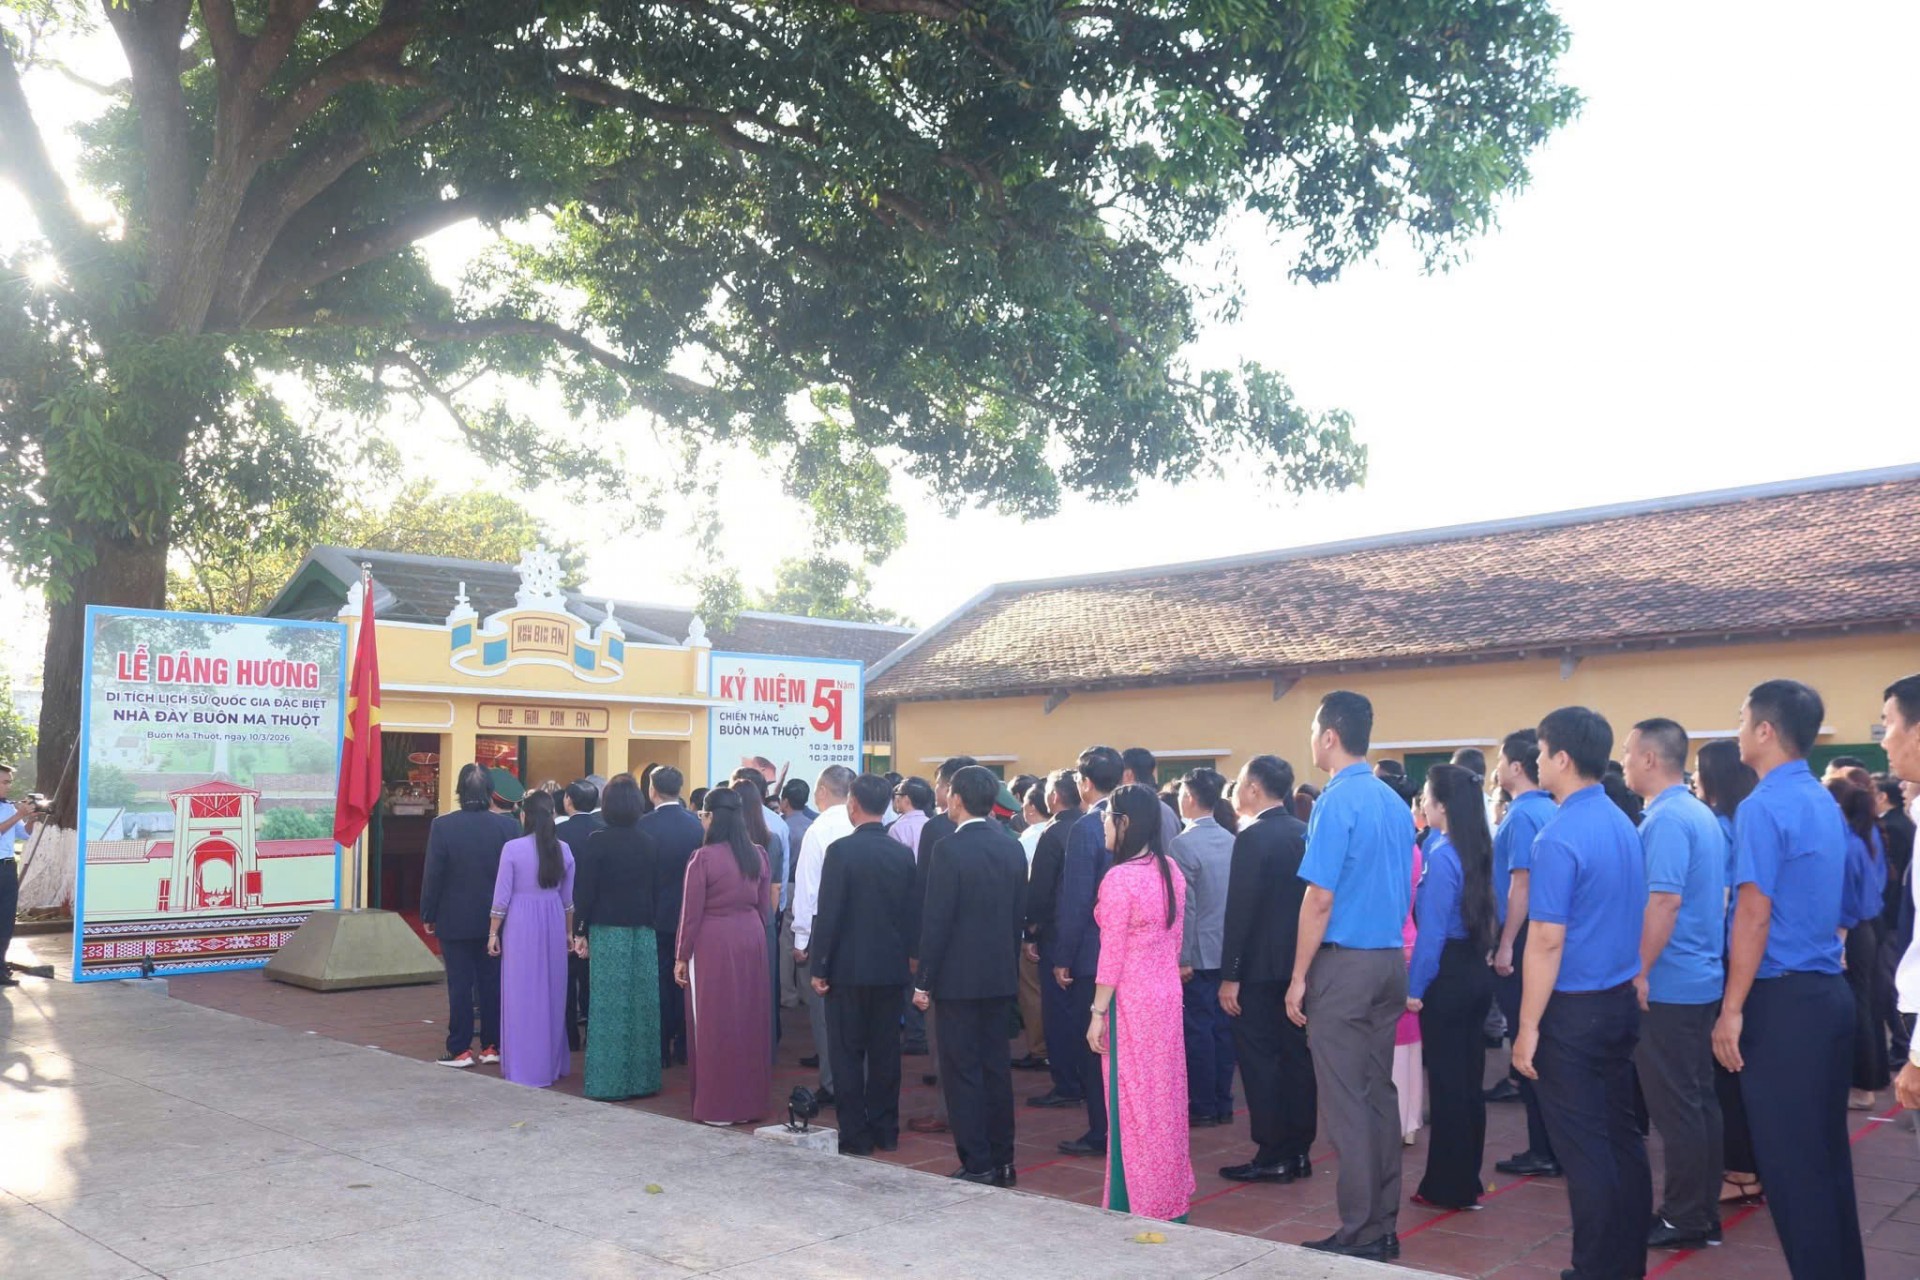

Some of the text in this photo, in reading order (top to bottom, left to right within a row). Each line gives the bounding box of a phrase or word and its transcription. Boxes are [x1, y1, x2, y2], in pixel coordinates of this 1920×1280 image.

[118, 644, 318, 689] LỄ DÂNG HƯƠNG
[720, 668, 805, 708] KỶ NIỆM
[106, 690, 327, 711] DI TÍCH LỊCH SỬ QUỐC GIA ĐẶC BIỆT
[809, 679, 843, 740] 51
[113, 708, 321, 729] NHÀ ĐÀY BUÔN MA THUỘT
[719, 710, 779, 722] CHIẾN THẮNG
[176, 731, 190, 739] Ma
[249, 733, 291, 742] 10/3/2026
[719, 723, 805, 739] BUÔN MA THUỘT
[809, 743, 855, 752] 10/3/1975
